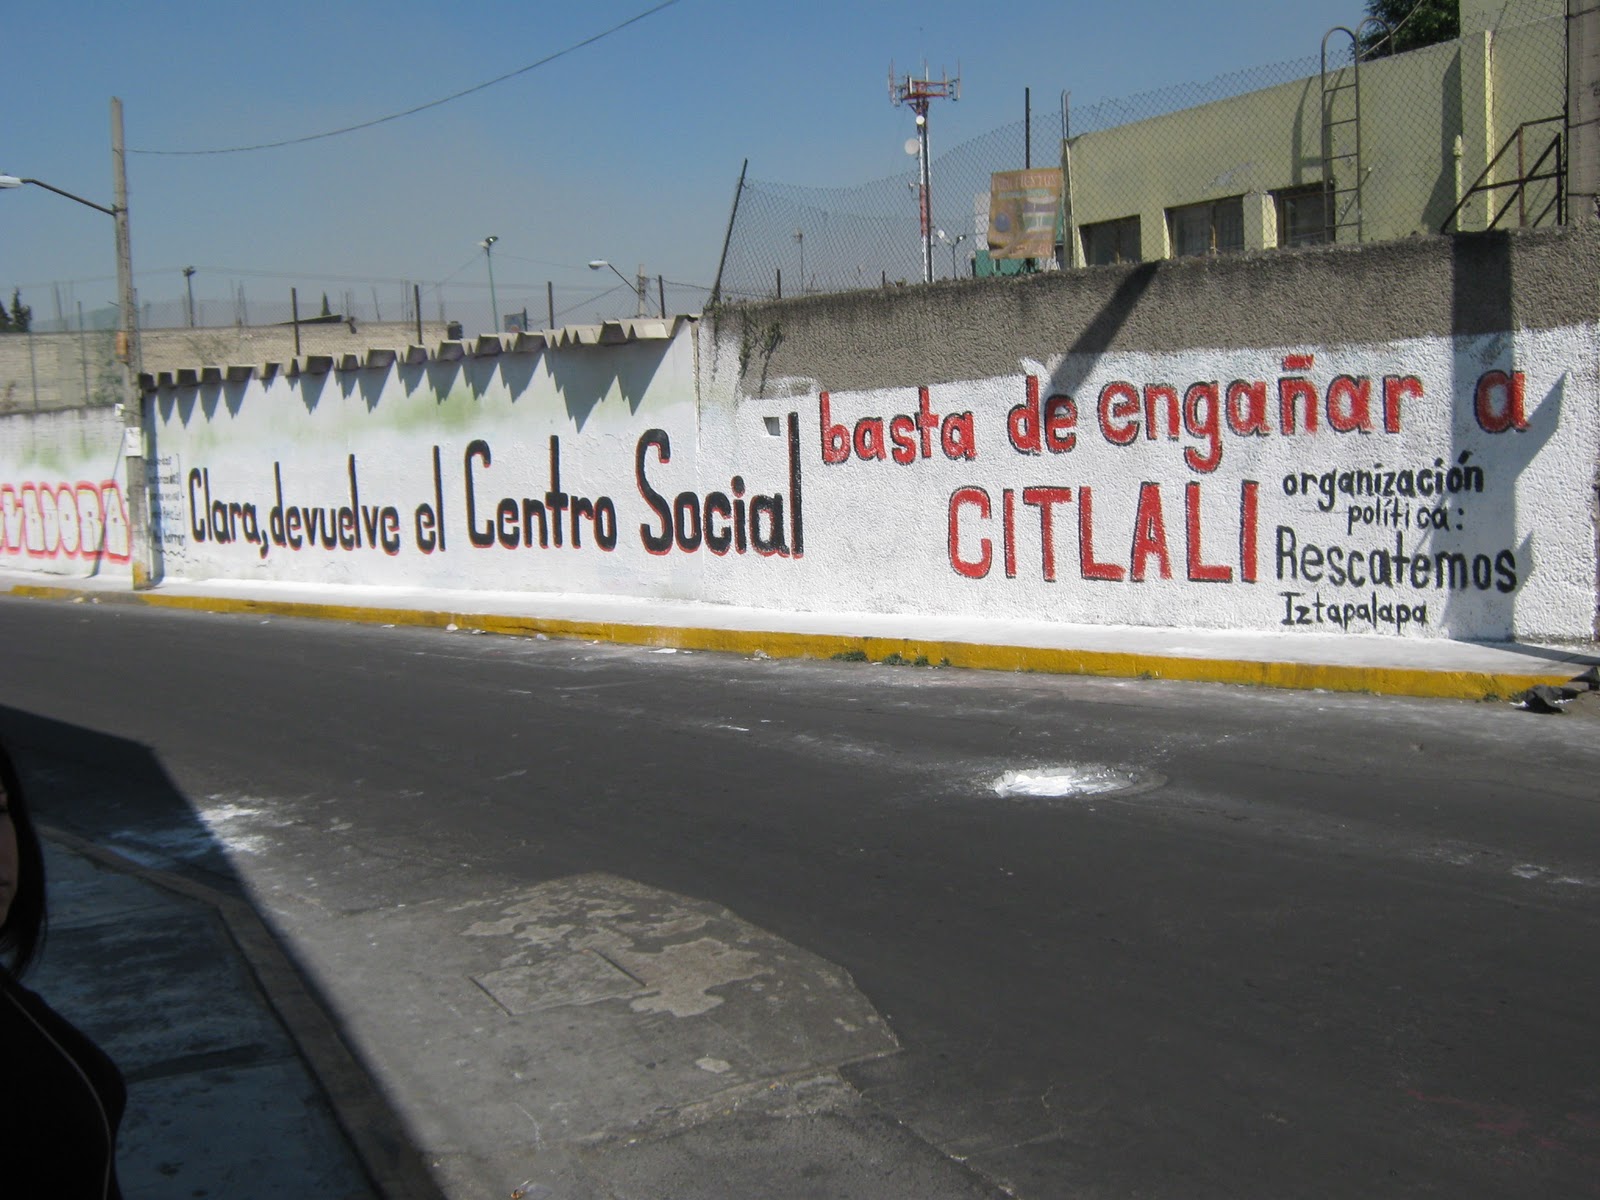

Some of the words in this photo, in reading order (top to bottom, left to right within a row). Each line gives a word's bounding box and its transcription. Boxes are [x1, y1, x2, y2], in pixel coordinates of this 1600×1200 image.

[819, 385, 976, 466] basta
[1007, 374, 1079, 456] de
[1097, 353, 1425, 474] engañar
[1474, 369, 1531, 433] a
[188, 467, 269, 560] Clara,
[269, 453, 401, 556] devuelve
[414, 445, 447, 555] el
[464, 434, 618, 552] Centro
[635, 411, 804, 560] Social
[1282, 449, 1484, 512] organización
[948, 479, 1259, 584] CITLALI
[1276, 524, 1518, 594] Rescatemos
[1279, 591, 1428, 633] Iztapalapa
